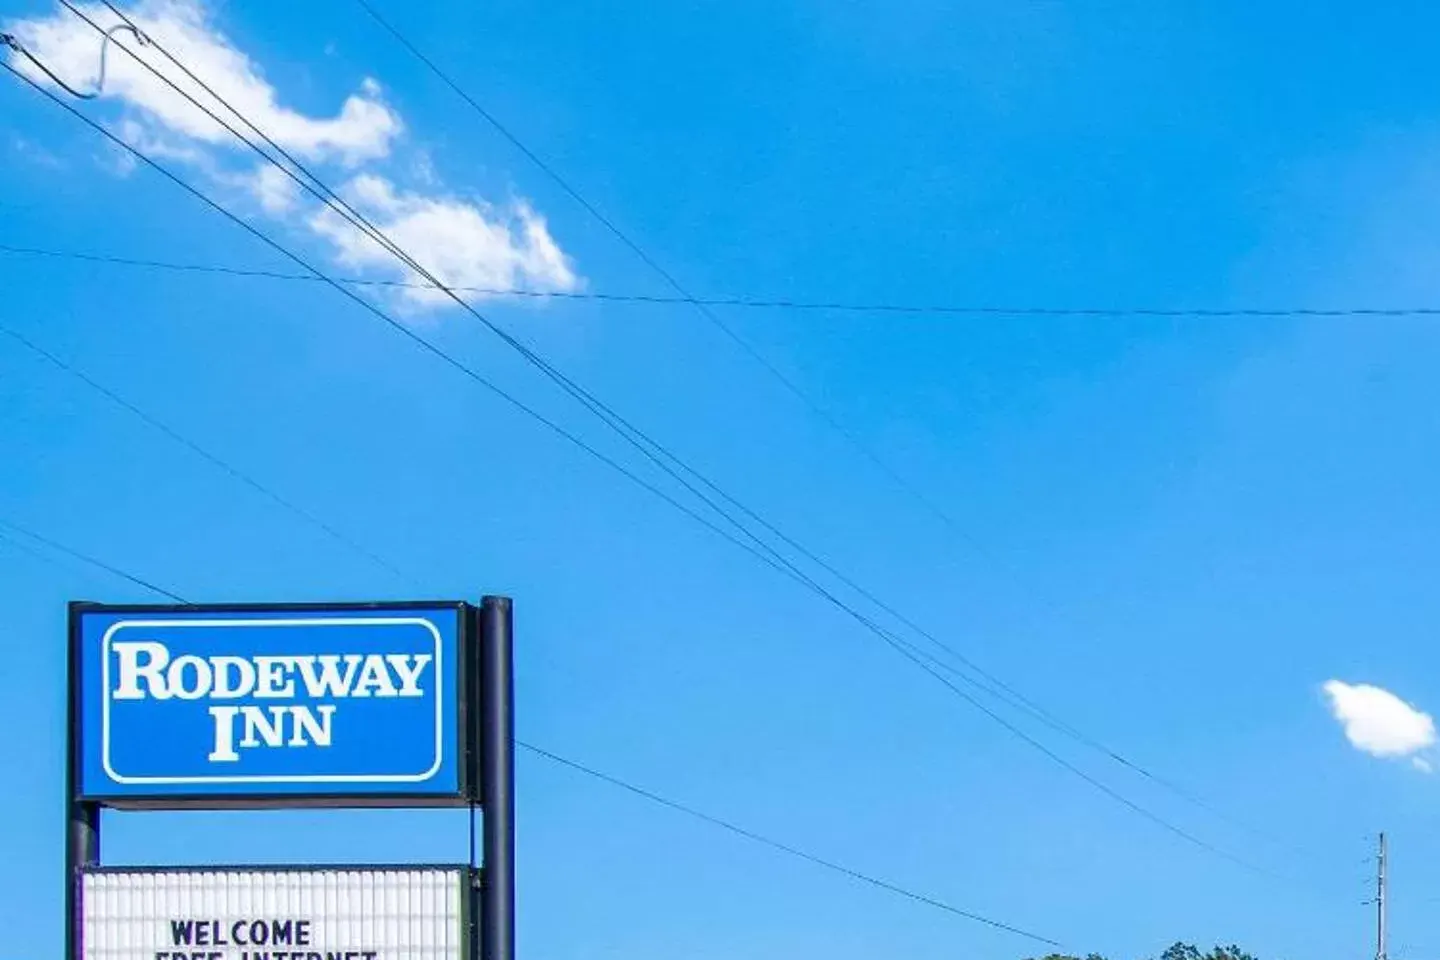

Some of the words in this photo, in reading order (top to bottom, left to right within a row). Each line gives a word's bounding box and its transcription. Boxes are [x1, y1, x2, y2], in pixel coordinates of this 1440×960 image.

[112, 641, 432, 700] RODEWAY
[208, 705, 336, 762] INN
[171, 919, 311, 946] WELCOME
